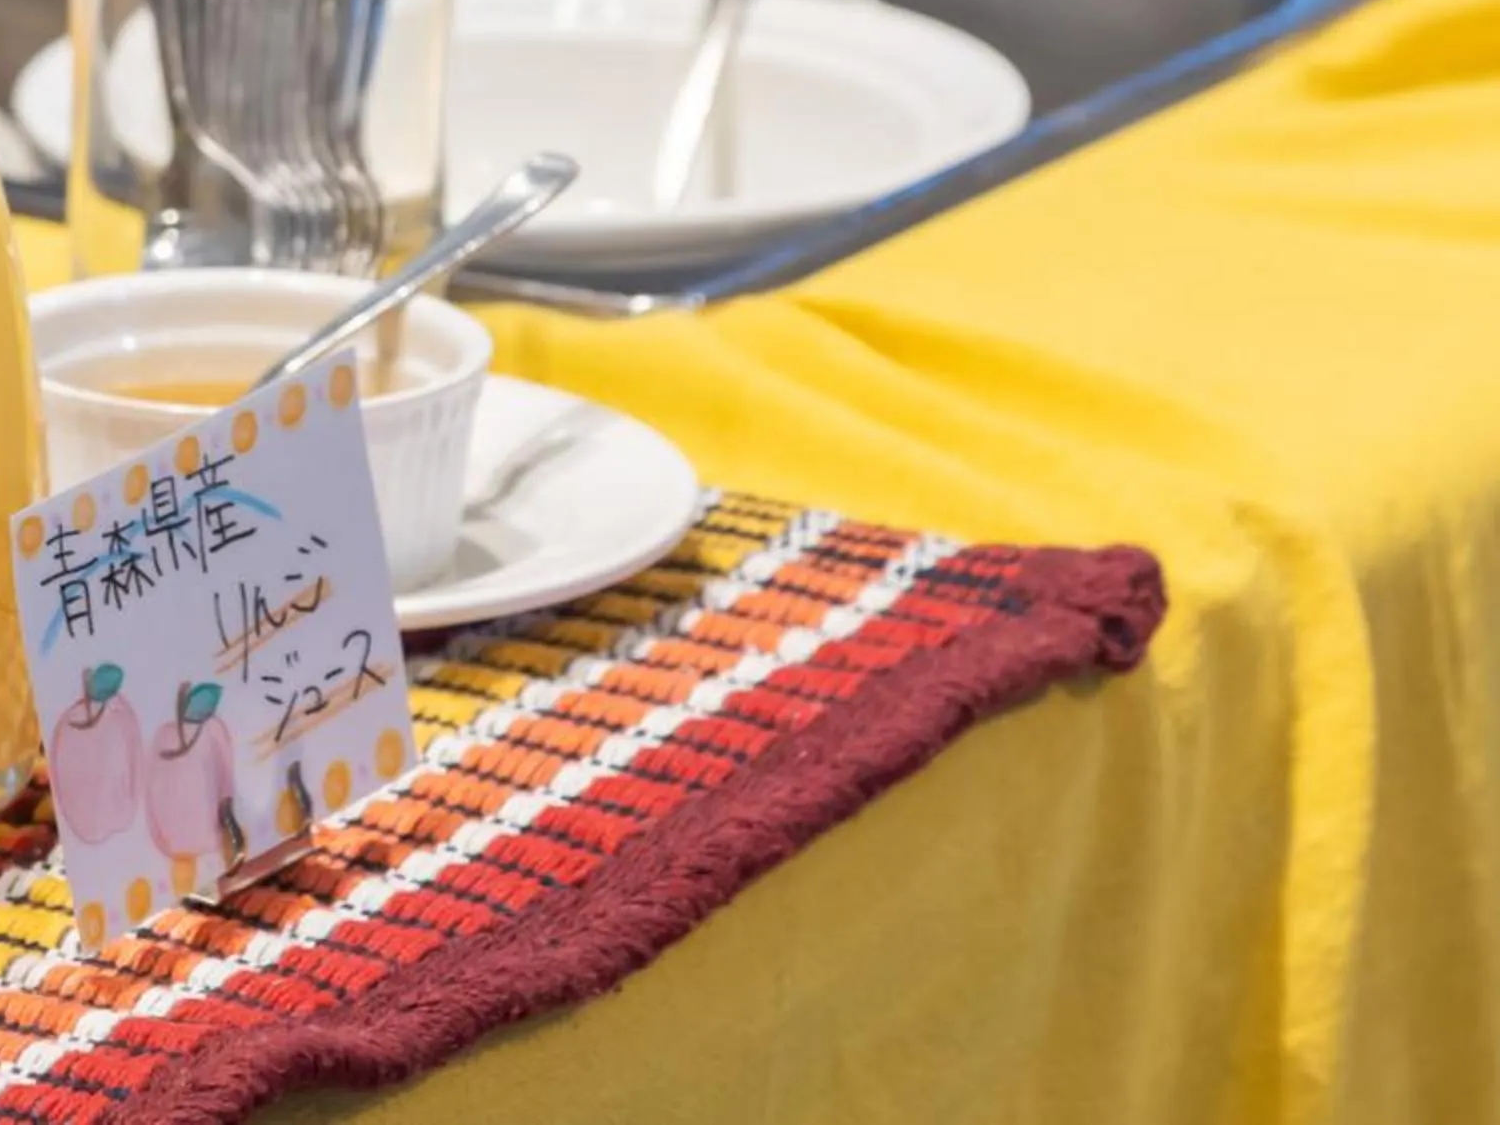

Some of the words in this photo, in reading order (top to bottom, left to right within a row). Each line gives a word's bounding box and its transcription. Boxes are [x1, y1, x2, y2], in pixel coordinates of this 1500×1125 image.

[41, 453, 257, 638] 青森県産
[260, 629, 387, 743] ジュース
